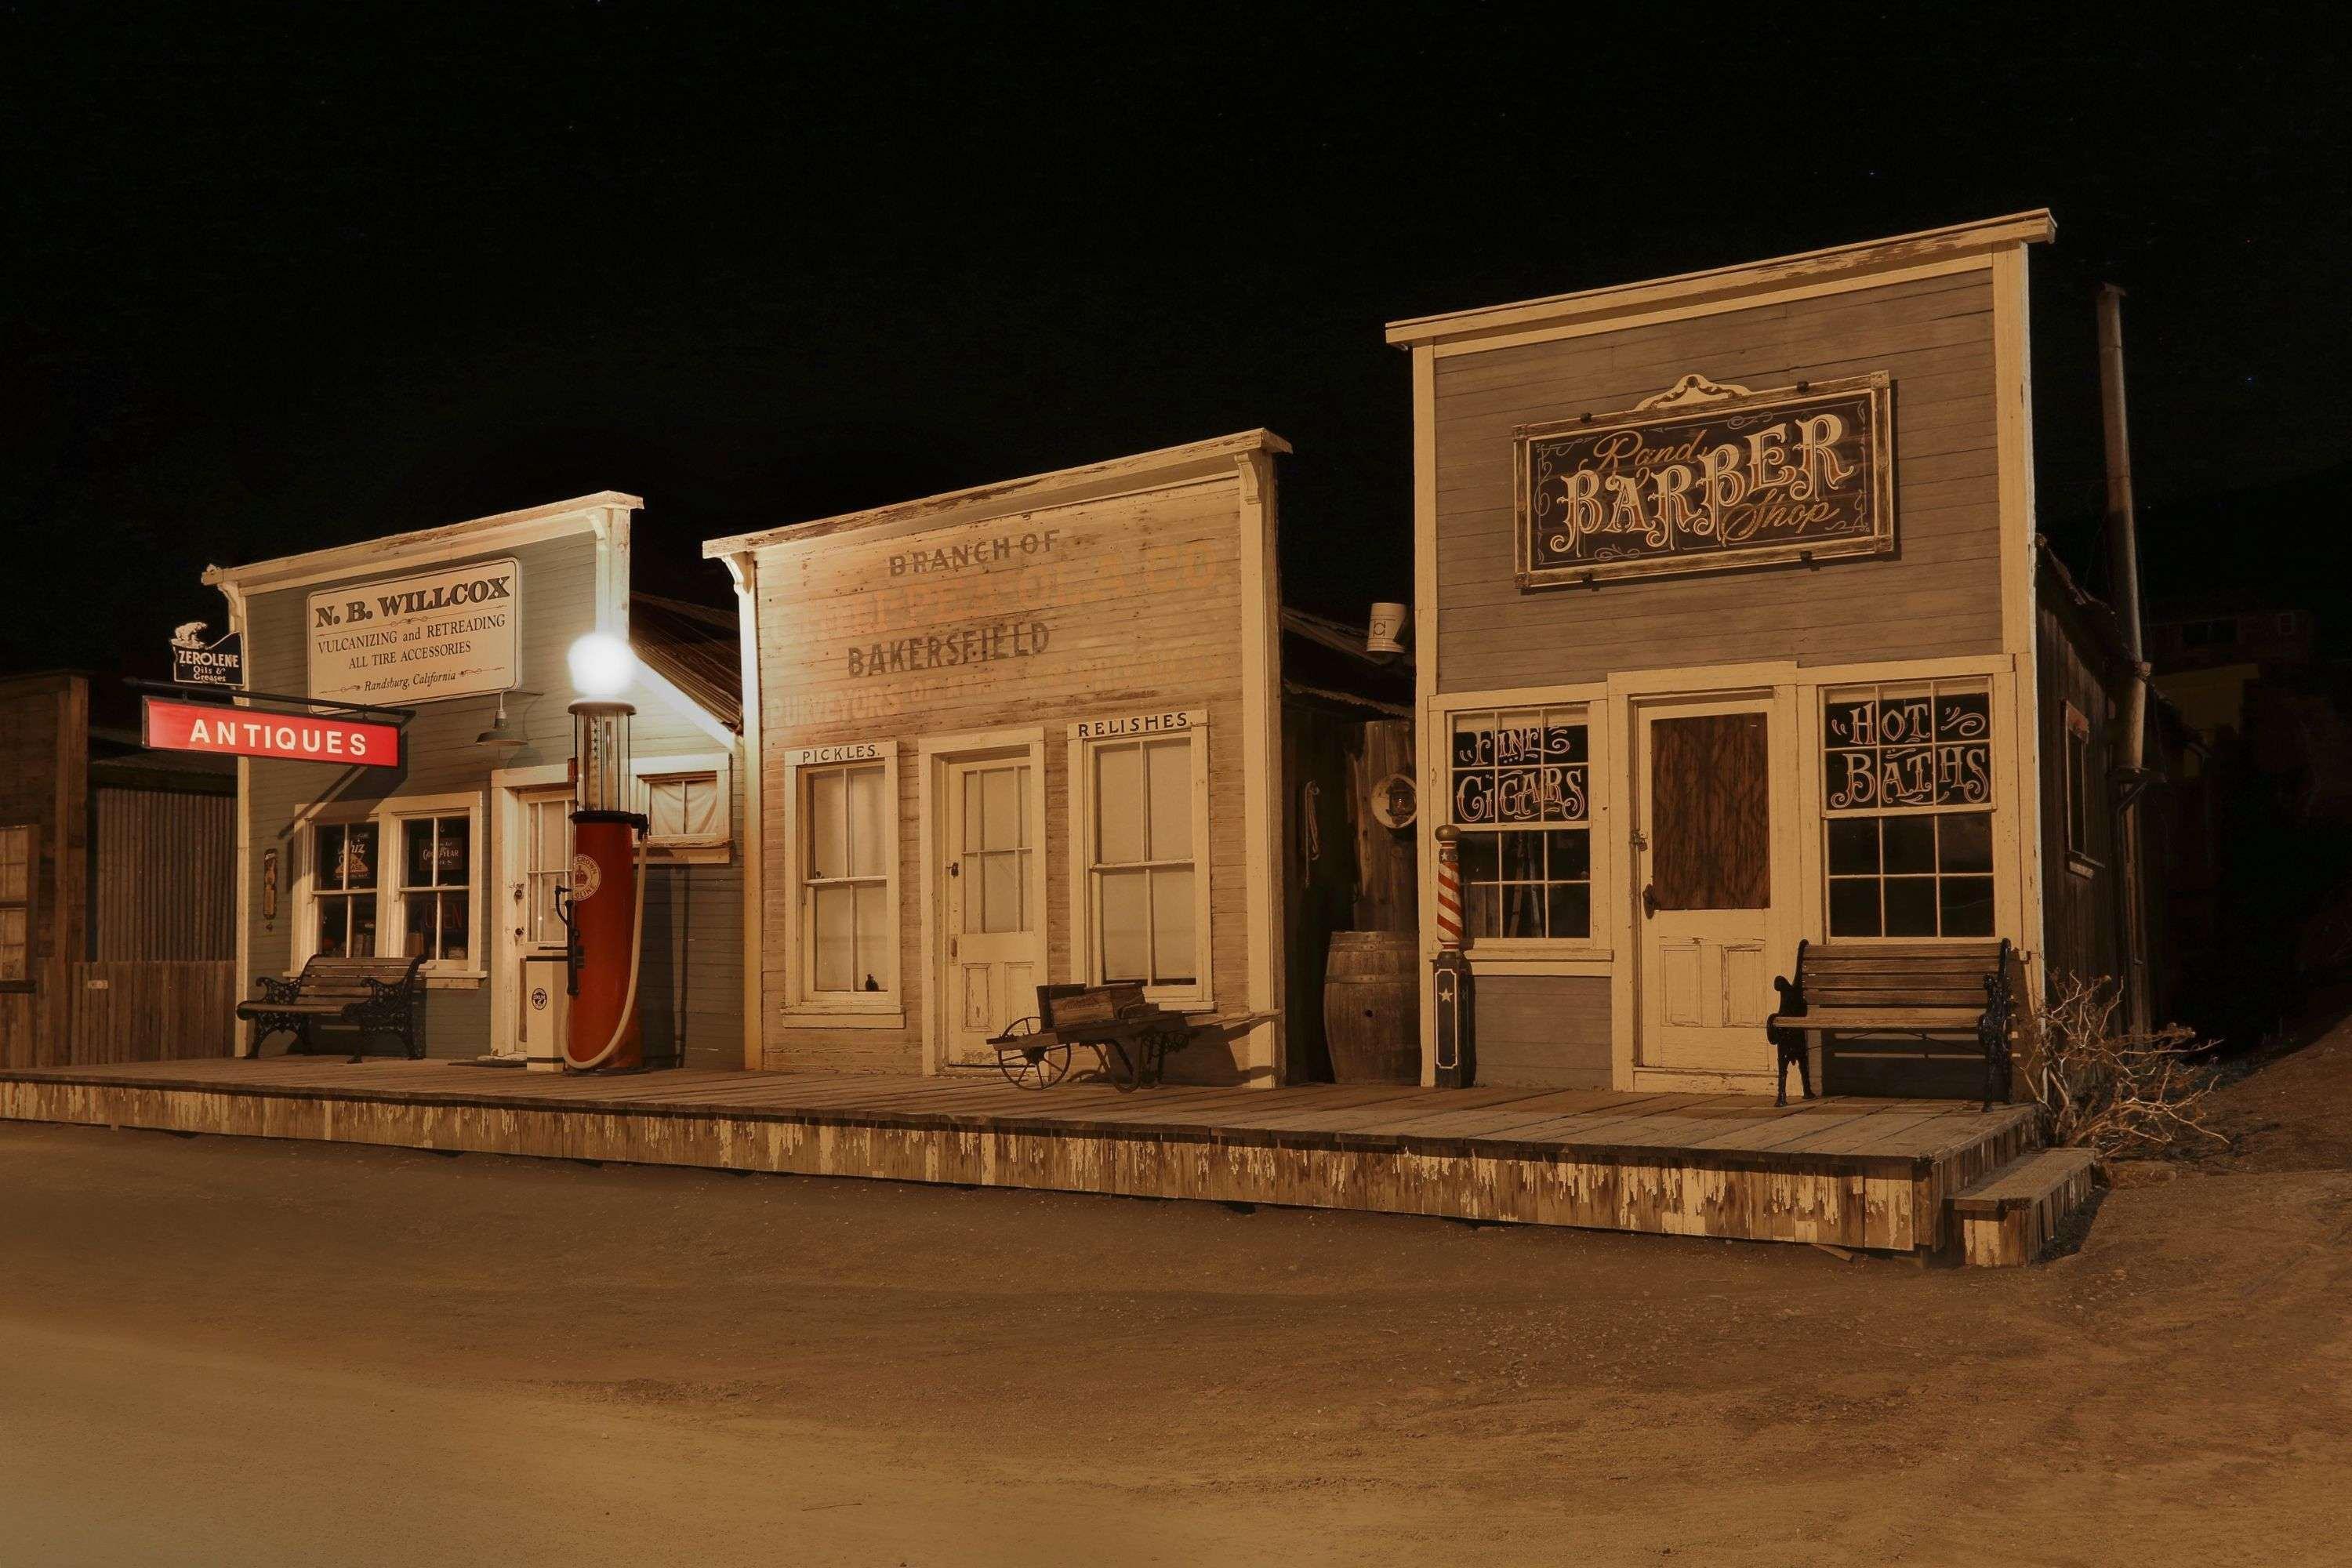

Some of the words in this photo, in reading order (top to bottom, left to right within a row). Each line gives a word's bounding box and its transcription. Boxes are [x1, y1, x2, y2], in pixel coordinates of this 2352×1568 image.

[1581, 429, 1709, 475] Rand
[1550, 415, 1854, 557] BARBER
[1722, 489, 1840, 541] Shop
[889, 537, 1011, 577] BRANCH
[1021, 528, 1060, 555] OF
[315, 605, 340, 628] N.
[346, 600, 373, 623] B.
[377, 575, 510, 618] WILLCOX
[318, 630, 397, 654] VULCANIZING
[402, 626, 421, 642] and
[427, 614, 506, 638] RETREADING
[848, 622, 1051, 678] BAKERSFIELD
[178, 650, 239, 668] ZEROLENE
[193, 665, 212, 675] Oils
[348, 656, 368, 670] ALL
[372, 652, 397, 666] TIRE
[400, 640, 472, 662] ACCESSORIES
[193, 673, 226, 682] Greases
[364, 677, 411, 692] Randsburg,
[412, 671, 456, 688] California
[190, 719, 366, 757] ANTIQUES
[1849, 702, 1930, 745] HOT
[803, 744, 880, 764] PICKLES.
[1469, 726, 1560, 767] FINE
[1457, 768, 1585, 822] CIGARS
[1831, 746, 1989, 808] BATHS
[426, 902, 464, 928] OEN
